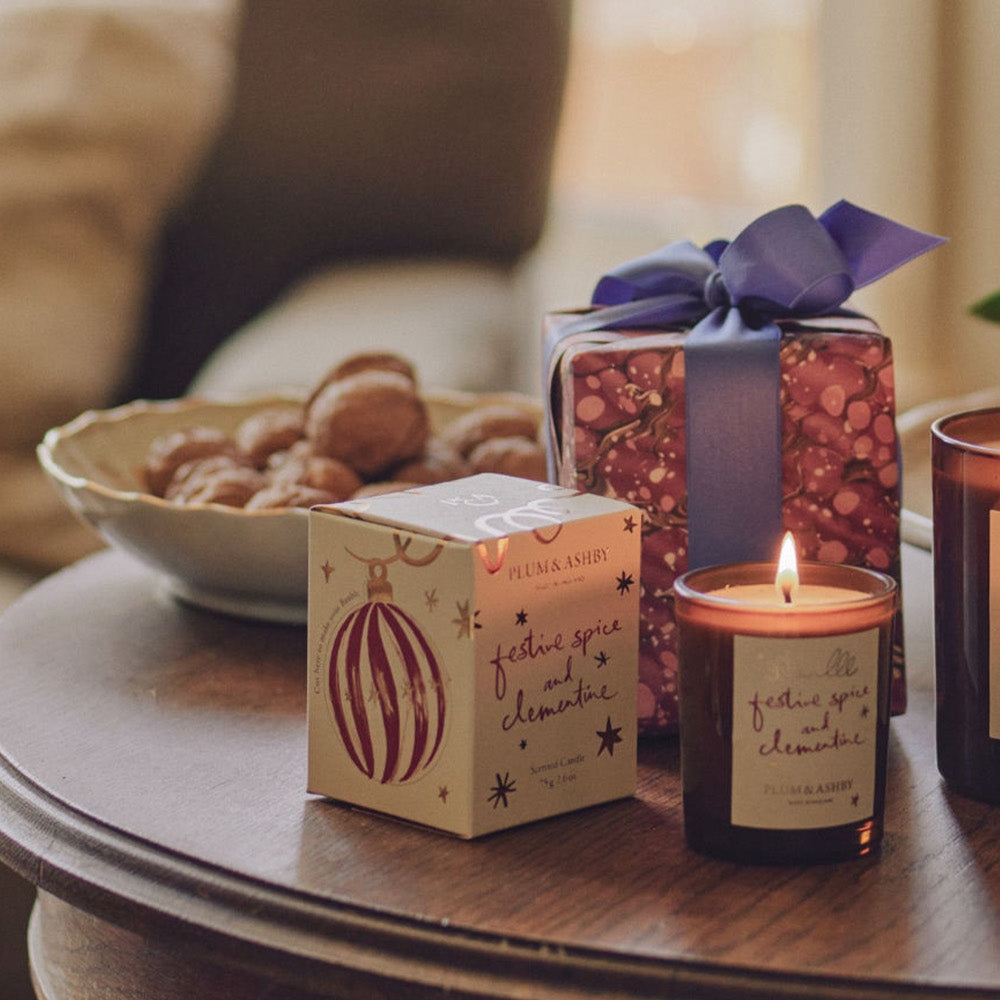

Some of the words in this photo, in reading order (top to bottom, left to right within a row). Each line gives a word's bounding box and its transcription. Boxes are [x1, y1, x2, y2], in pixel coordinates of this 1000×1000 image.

[490, 628, 564, 700] festive
[571, 619, 622, 659] spice
[544, 656, 574, 693] and
[502, 680, 620, 731] clementine
[748, 687, 820, 732] festive
[829, 686, 870, 712] spice
[801, 711, 829, 735] and
[759, 729, 866, 755] clementine
